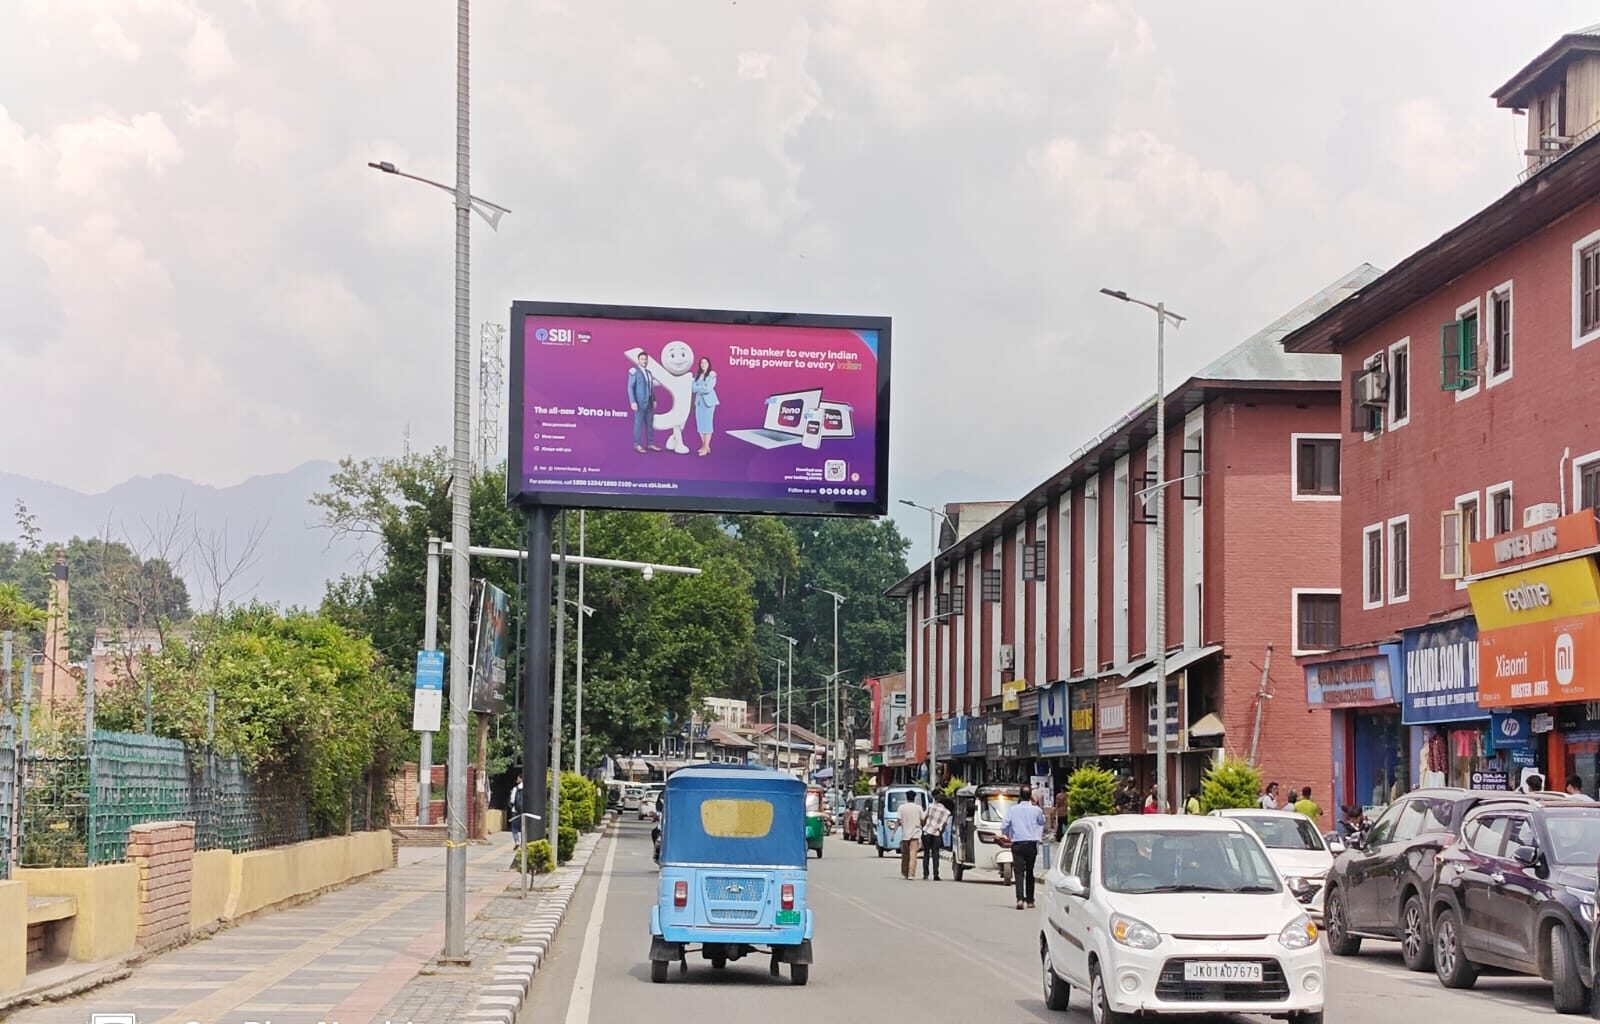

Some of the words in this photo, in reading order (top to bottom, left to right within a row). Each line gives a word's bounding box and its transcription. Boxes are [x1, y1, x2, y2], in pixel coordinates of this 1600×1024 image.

[549, 328, 572, 342] SBI
[729, 345, 749, 356] The
[750, 347, 785, 357] banker
[786, 348, 797, 358] to
[798, 350, 826, 361] every
[828, 350, 858, 360] Indian
[729, 356, 761, 369] brings
[762, 359, 793, 369] power
[794, 359, 806, 368] to
[807, 361, 835, 371] every
[534, 406, 547, 414] The
[548, 406, 576, 415] all-new
[1504, 580, 1551, 612] realme
[1407, 643, 1464, 694] HANDLOOM
[1468, 641, 1480, 688] H
[1496, 651, 1528, 678] Xiaomi
[1511, 682, 1532, 698] MASTER
[1504, 718, 1518, 736] hp
